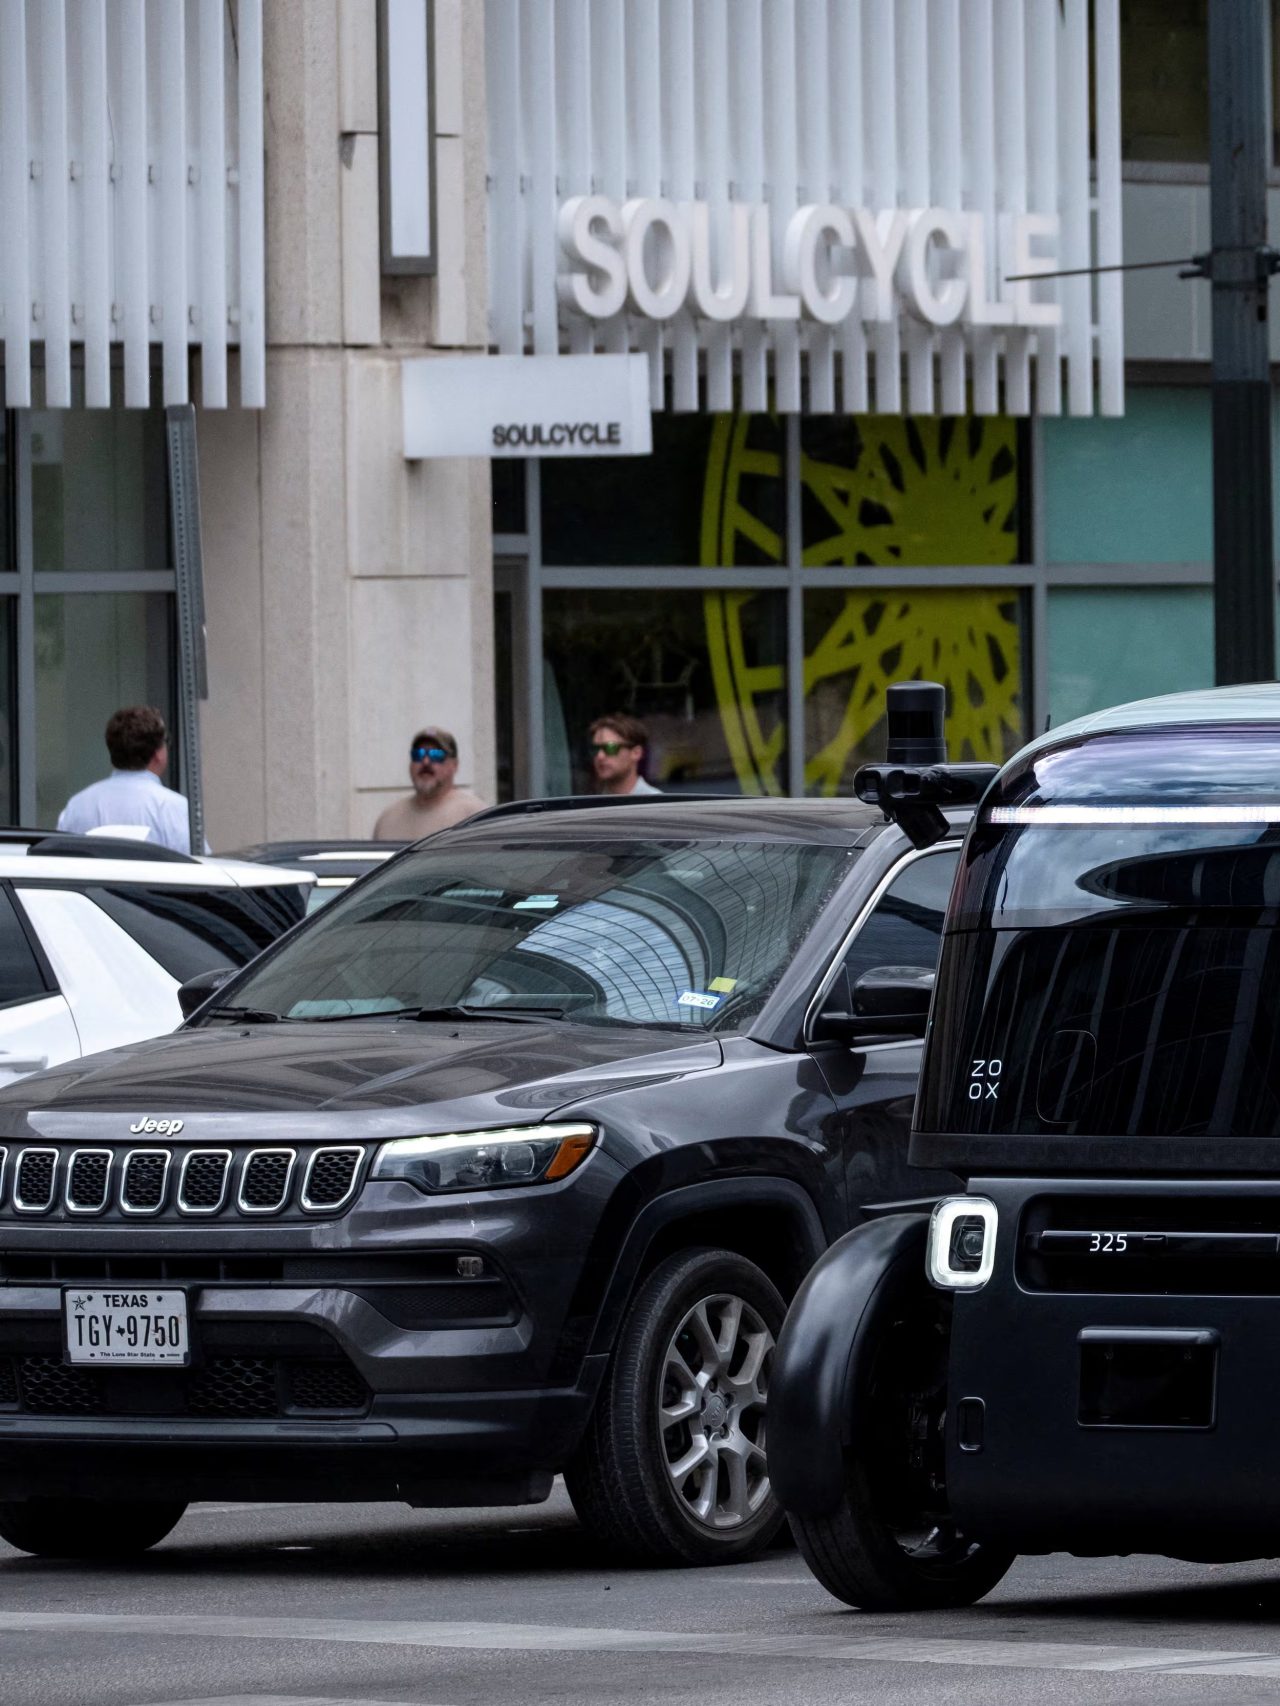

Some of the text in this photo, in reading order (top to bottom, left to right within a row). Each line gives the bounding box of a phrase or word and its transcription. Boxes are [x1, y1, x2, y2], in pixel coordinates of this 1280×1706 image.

[557, 197, 1062, 326] SOULCYCLE
[491, 421, 621, 448] SOULCYCLE
[130, 1116, 185, 1137] Jeep
[1088, 1232, 1129, 1252] 325
[102, 1294, 149, 1308] TEXAS
